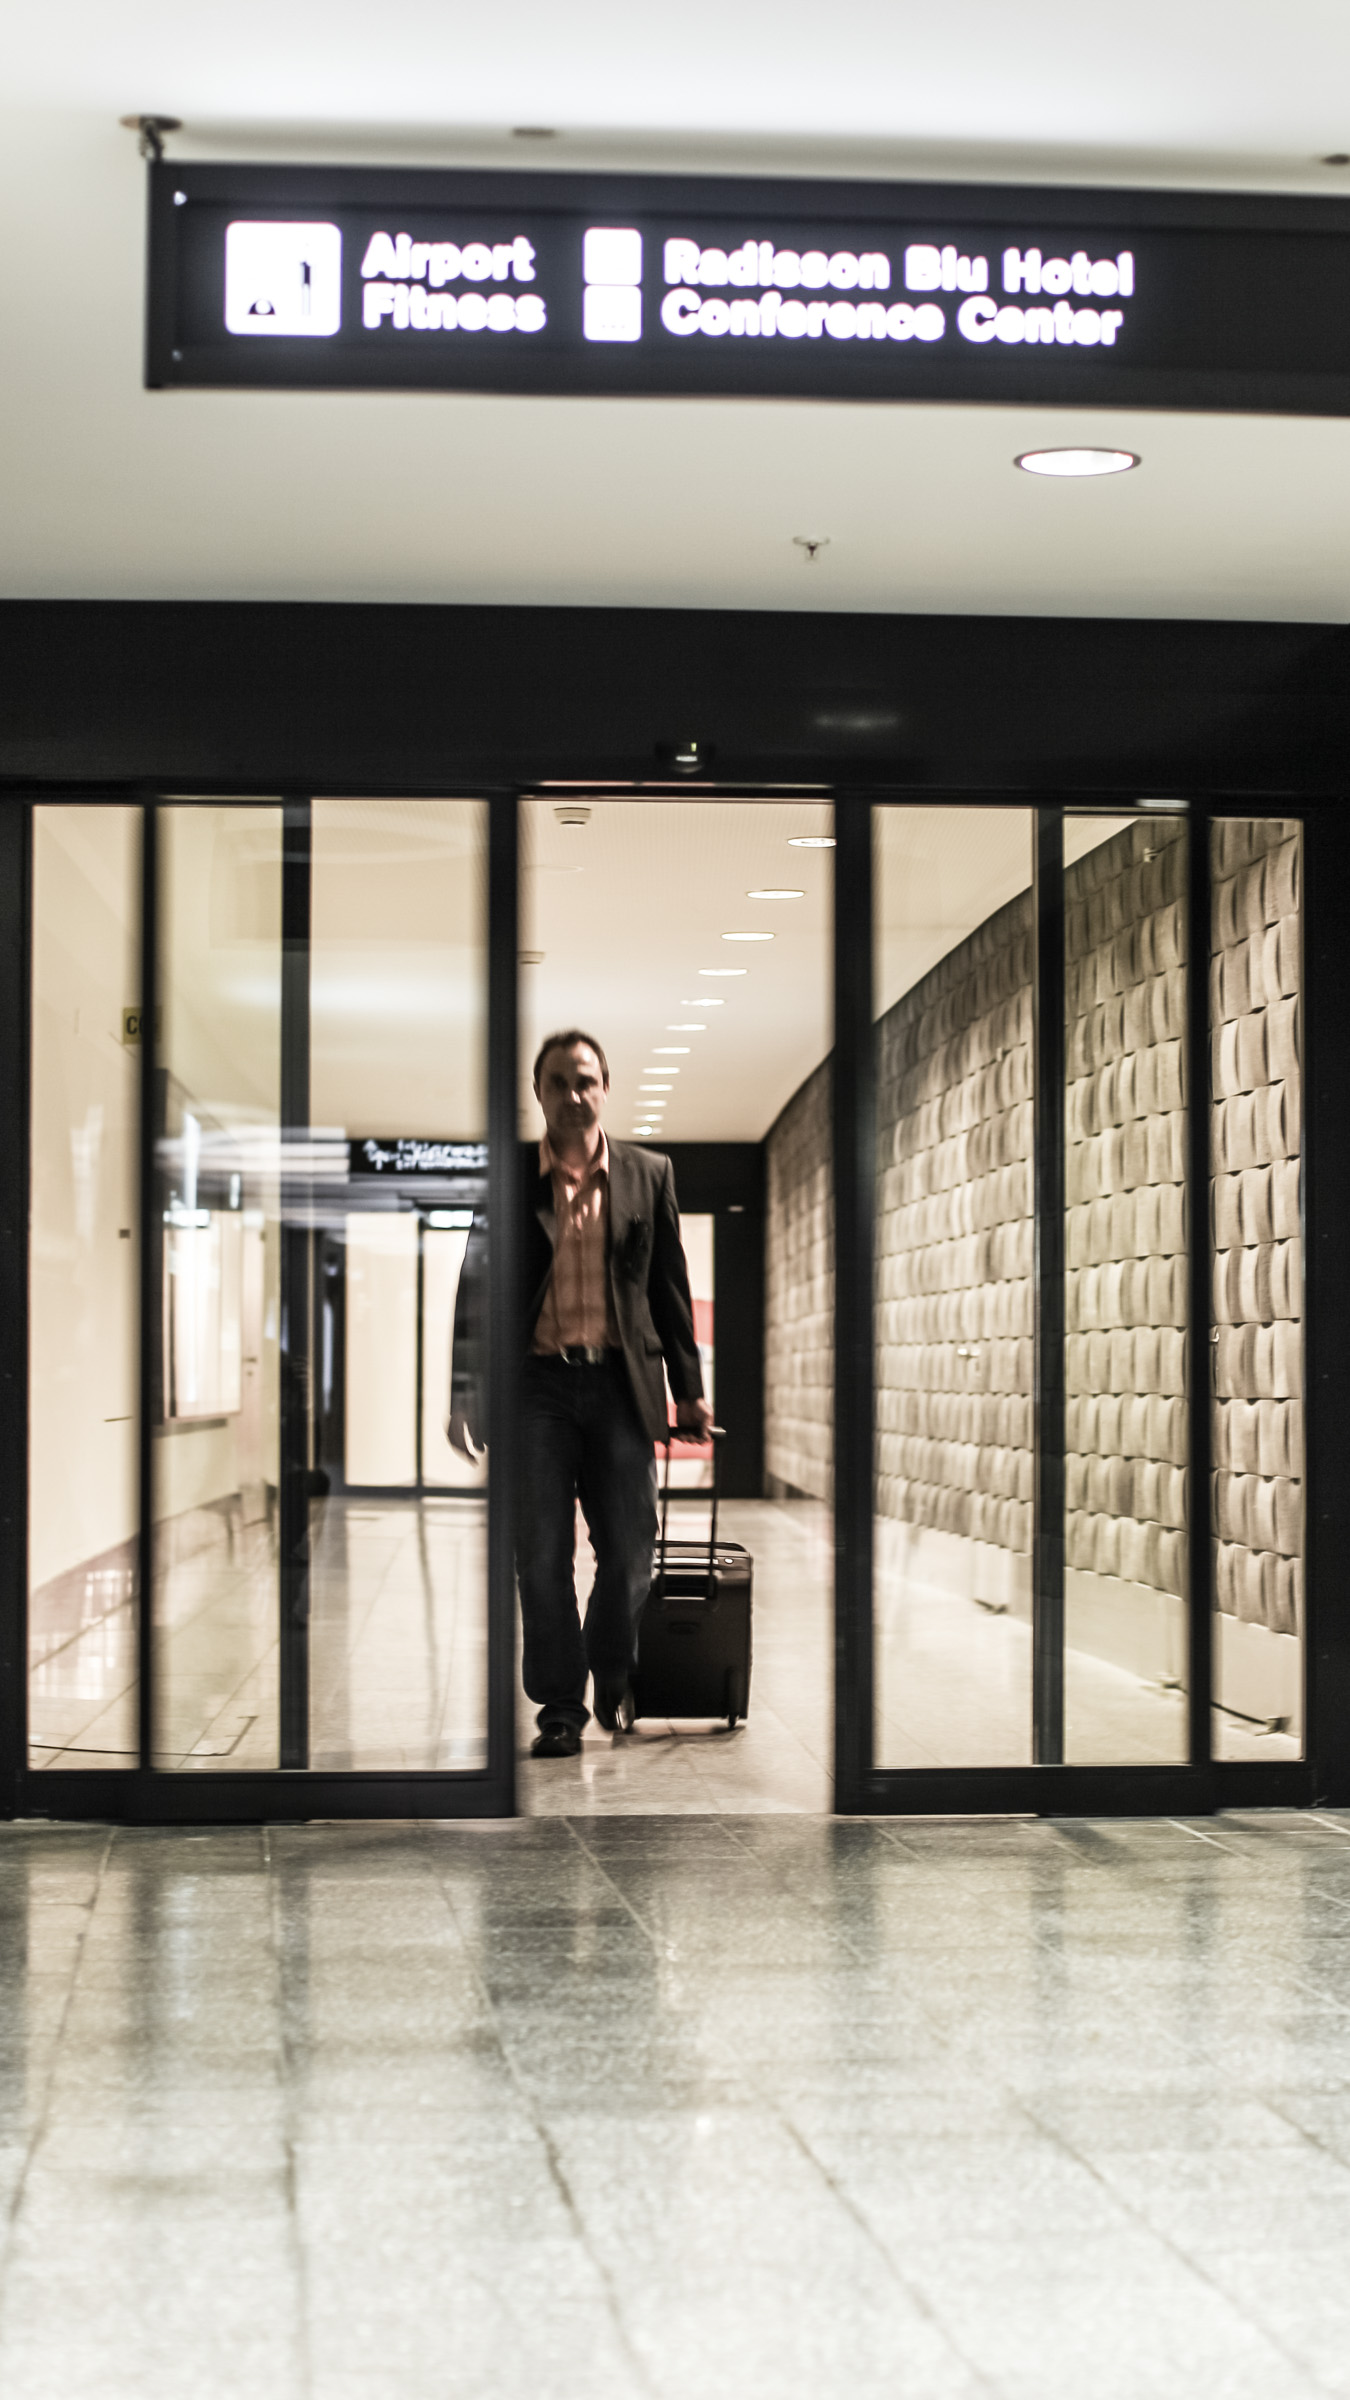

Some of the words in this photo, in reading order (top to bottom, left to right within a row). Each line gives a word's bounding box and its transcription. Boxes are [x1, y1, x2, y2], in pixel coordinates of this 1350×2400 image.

[361, 232, 535, 287] Airport
[664, 238, 890, 290] Radisson
[905, 244, 988, 293] Blu
[1003, 246, 1133, 297] Hotel
[363, 282, 546, 332] Fitness
[661, 288, 945, 341] Conference
[957, 294, 1123, 346] Center
